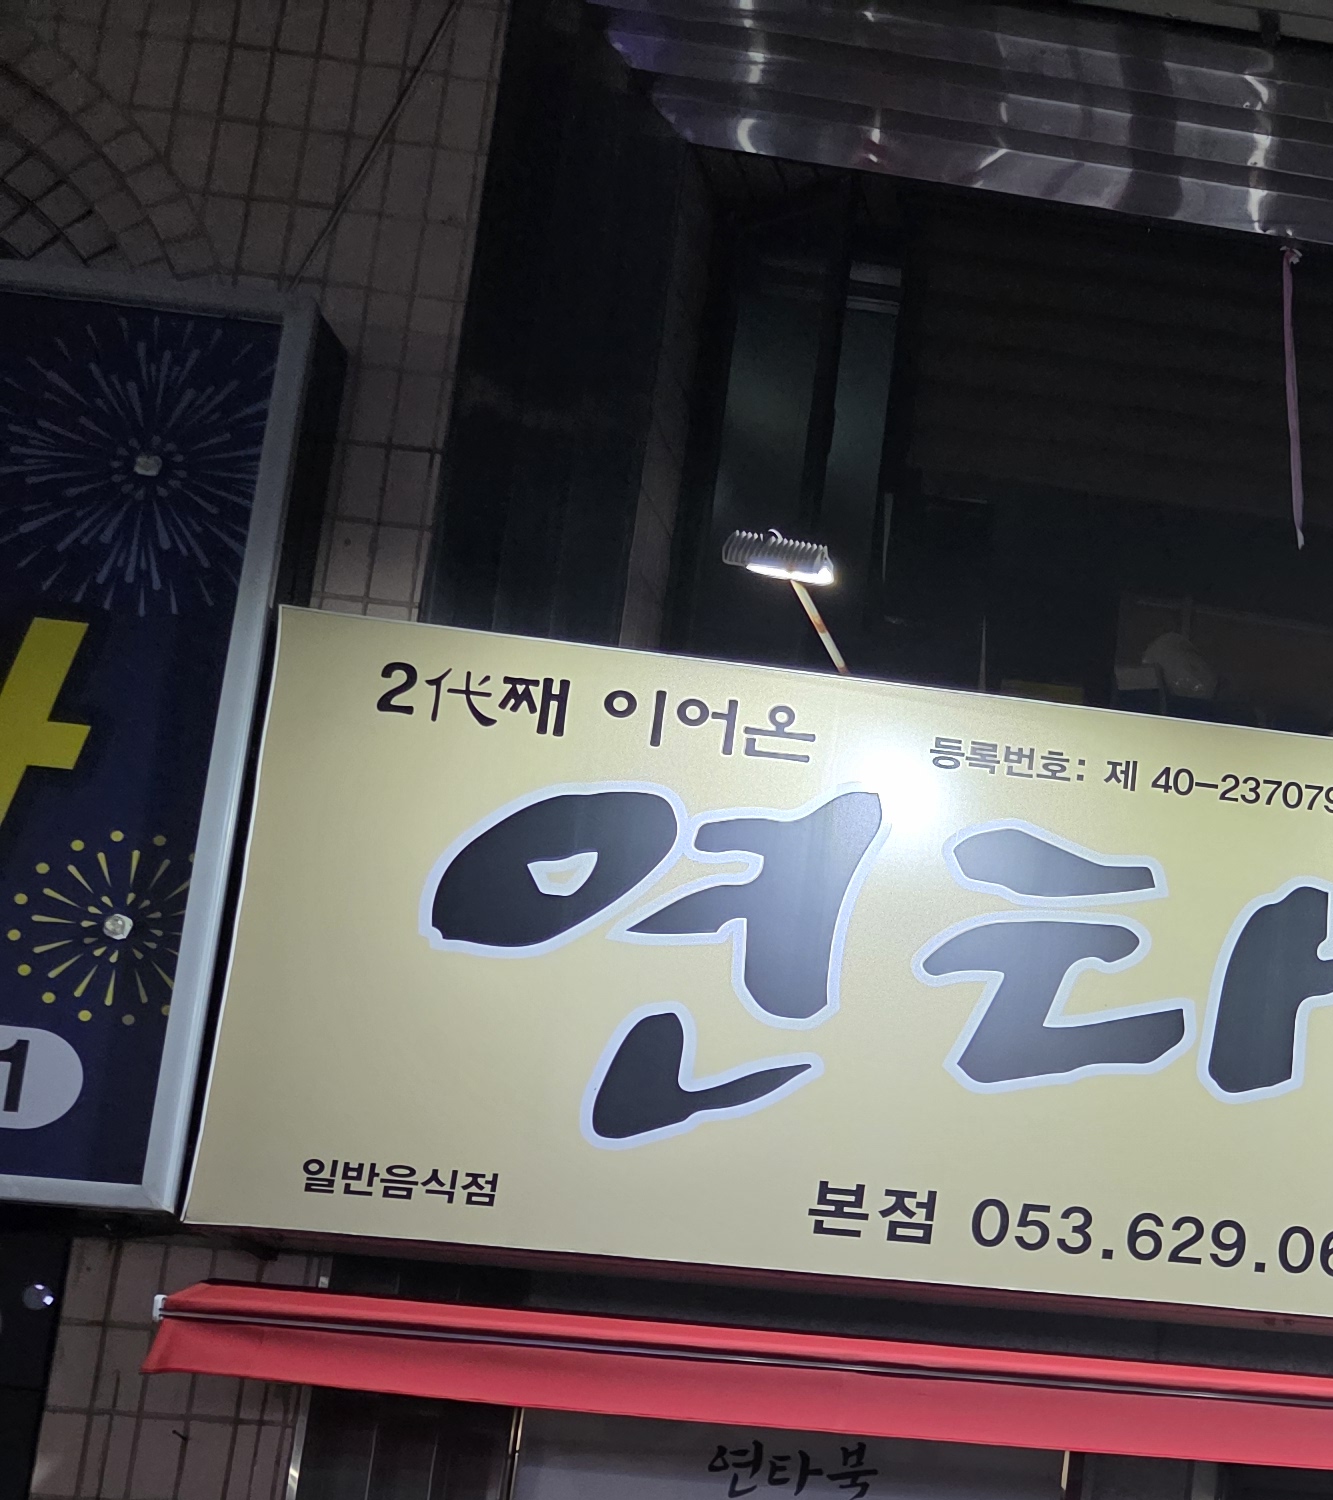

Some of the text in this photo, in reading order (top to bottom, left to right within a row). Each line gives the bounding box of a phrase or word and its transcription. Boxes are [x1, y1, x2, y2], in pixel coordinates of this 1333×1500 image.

[604, 687, 817, 764] 이어온
[928, 733, 1086, 785] 등록번호:
[1103, 755, 1140, 795] 제
[301, 1155, 500, 1209] 일반음식점
[807, 1181, 939, 1247] 본점
